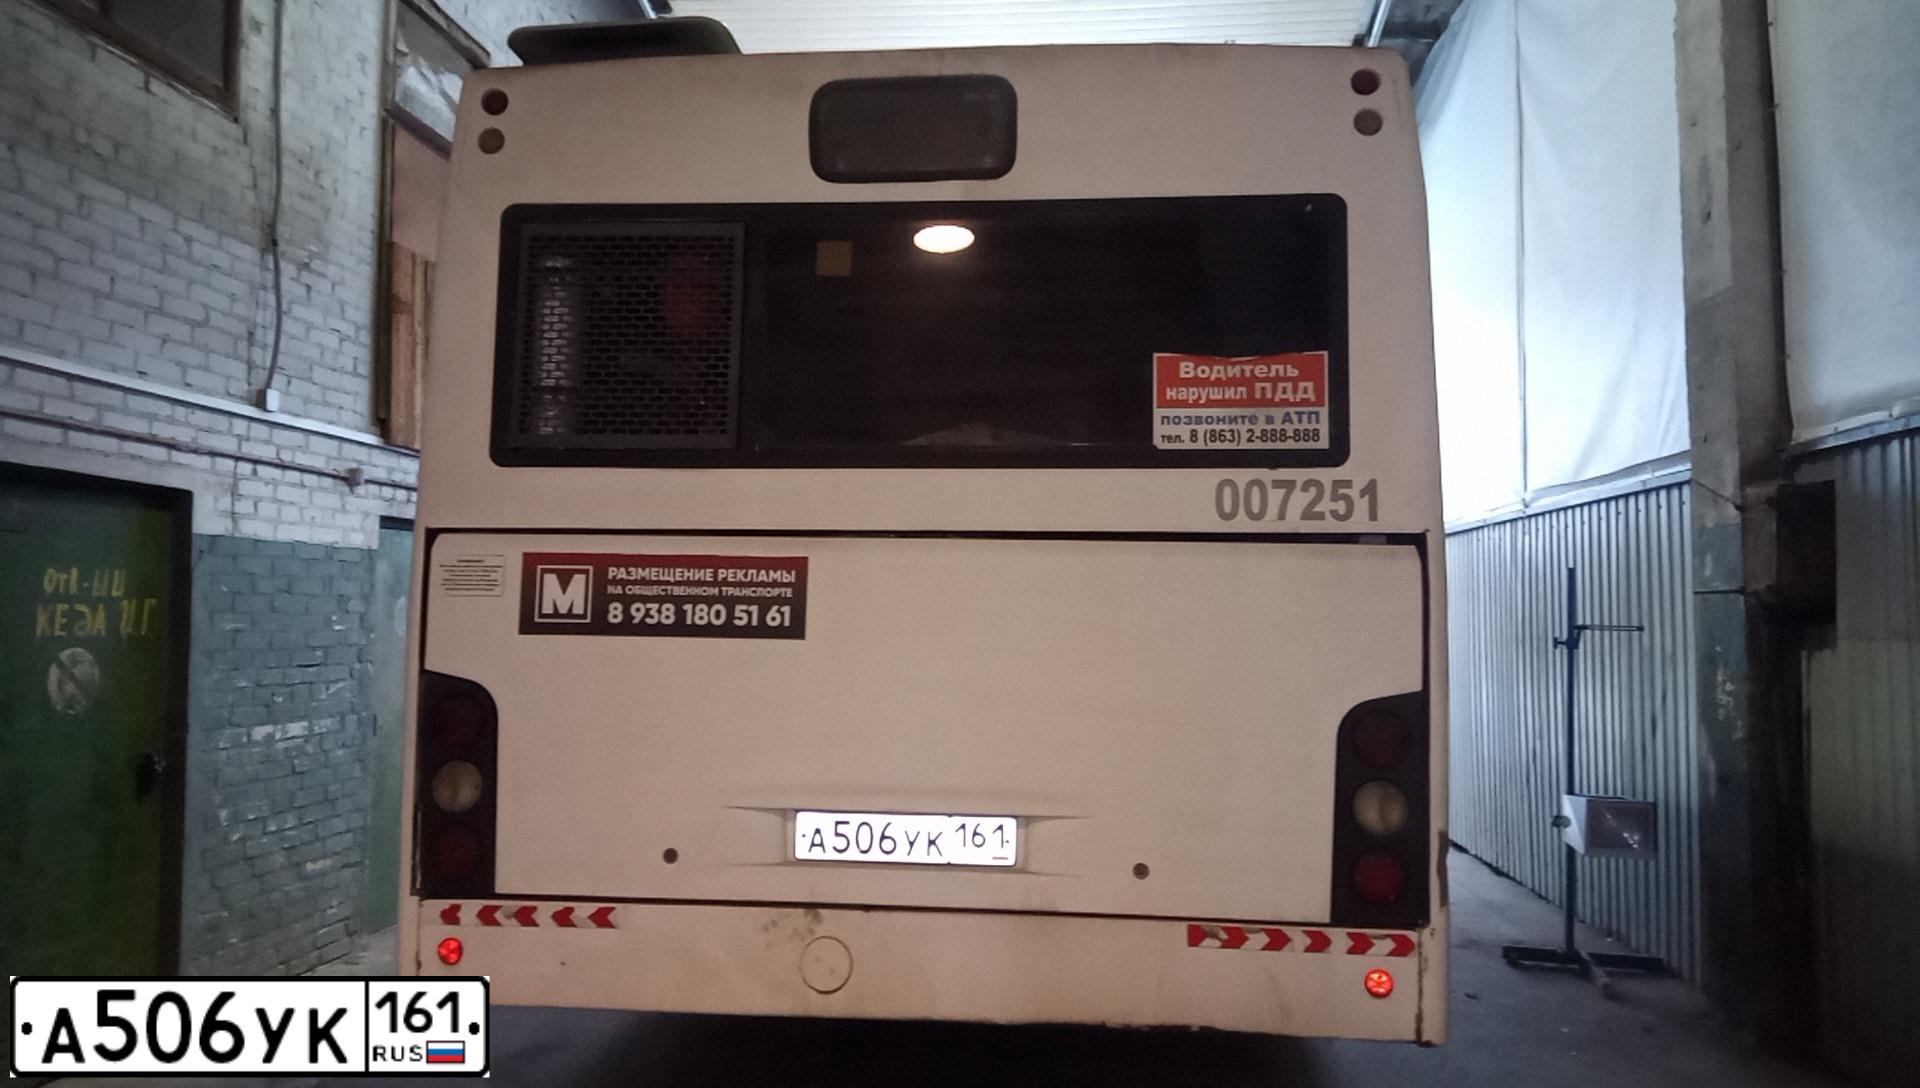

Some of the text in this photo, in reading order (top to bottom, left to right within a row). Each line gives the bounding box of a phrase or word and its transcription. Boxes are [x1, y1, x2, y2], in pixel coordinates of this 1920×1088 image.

[1178, 361, 1300, 381] Водитель
[1165, 381, 1317, 404] нарушил ПДД
[1160, 411, 1320, 426] позвоните в АТП
[1160, 428, 1321, 446] тел. 8 (863) 2-888-888
[1214, 478, 1379, 522] 007251
[607, 566, 796, 582] РАЗМЕЩЕНИЕ РЕКЛАМЫ
[606, 584, 793, 597] НА ОБЩЕСТВЕННОМ ТРАНСПОРТЕ
[607, 602, 792, 627] 8 938 180 51 61
[808, 820, 1004, 856] А506УК 161
